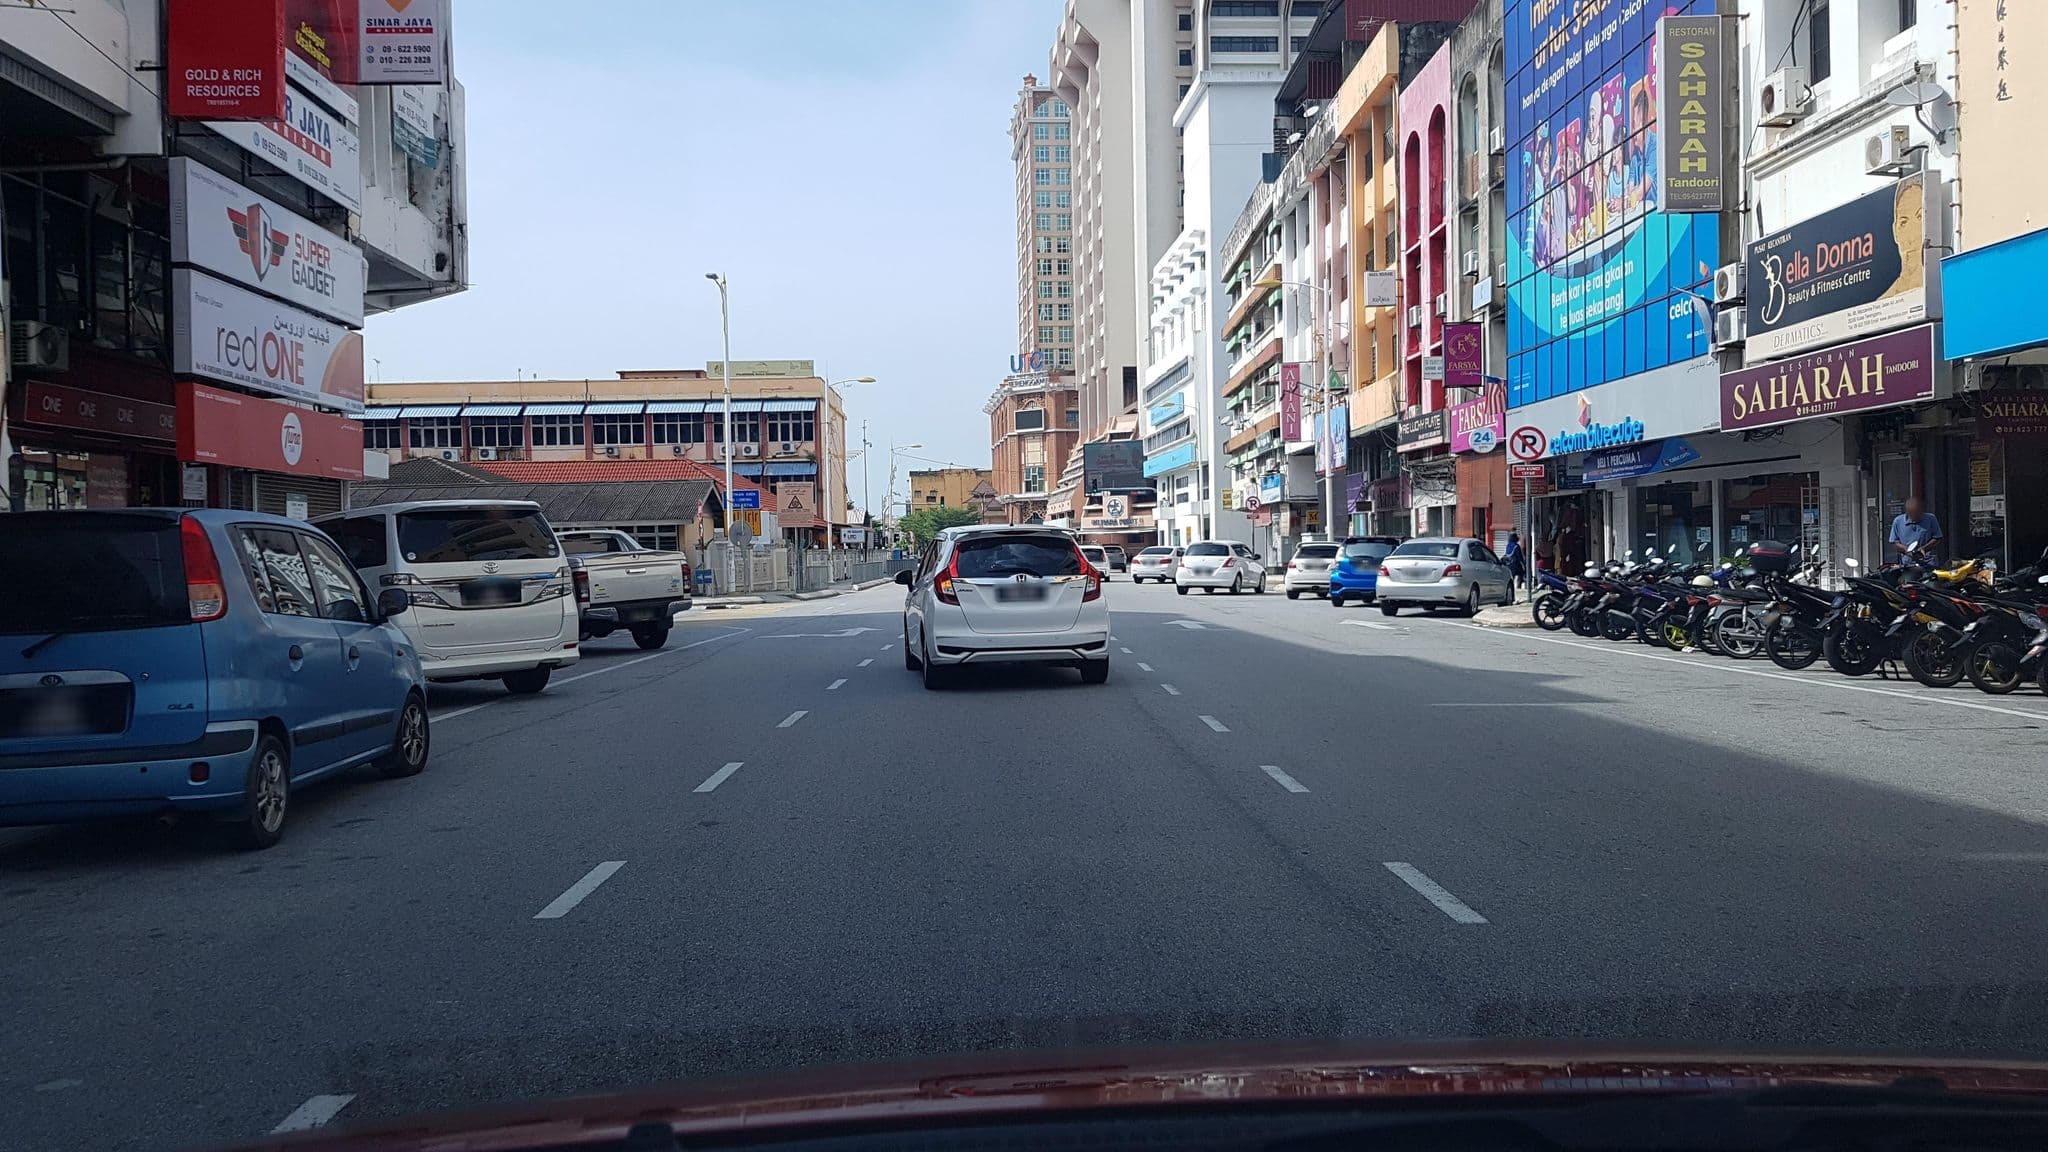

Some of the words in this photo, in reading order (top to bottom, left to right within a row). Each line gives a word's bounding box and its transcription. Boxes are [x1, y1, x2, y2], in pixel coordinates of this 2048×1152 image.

[366, 18, 400, 27] SINAR
[404, 18, 433, 27] JAYA
[1669, 26, 1716, 37] RESTORAN
[398, 45, 412, 53] 622
[413, 45, 431, 53] 5900
[185, 69, 219, 81] GOLD
[222, 69, 230, 81] &
[233, 69, 262, 81] RICH
[187, 85, 261, 97] RESOURCES
[1679, 42, 1707, 173] SAHARAH
[299, 107, 331, 150] JAYA
[1667, 176, 1719, 188] Tandoori
[294, 233, 330, 272] SUPER
[1816, 232, 1873, 273] Donna
[292, 259, 336, 298] GADGET
[1788, 289, 1809, 305] Beauty
[1811, 284, 1816, 297] &
[1817, 276, 1842, 294] Fitness
[1843, 269, 1871, 286] Centre
[1773, 324, 1822, 349] DERMATICS
[1010, 351, 1045, 374] UTC
[1448, 361, 1478, 369] FARSYA
[1780, 348, 1855, 374] RESTORAN
[1733, 353, 1886, 420] SAHARAH
[1885, 360, 1919, 375] TANDOORI
[1823, 401, 1837, 411] 7777
[1474, 431, 1491, 443] 24
[1587, 415, 1644, 448] bluecube
